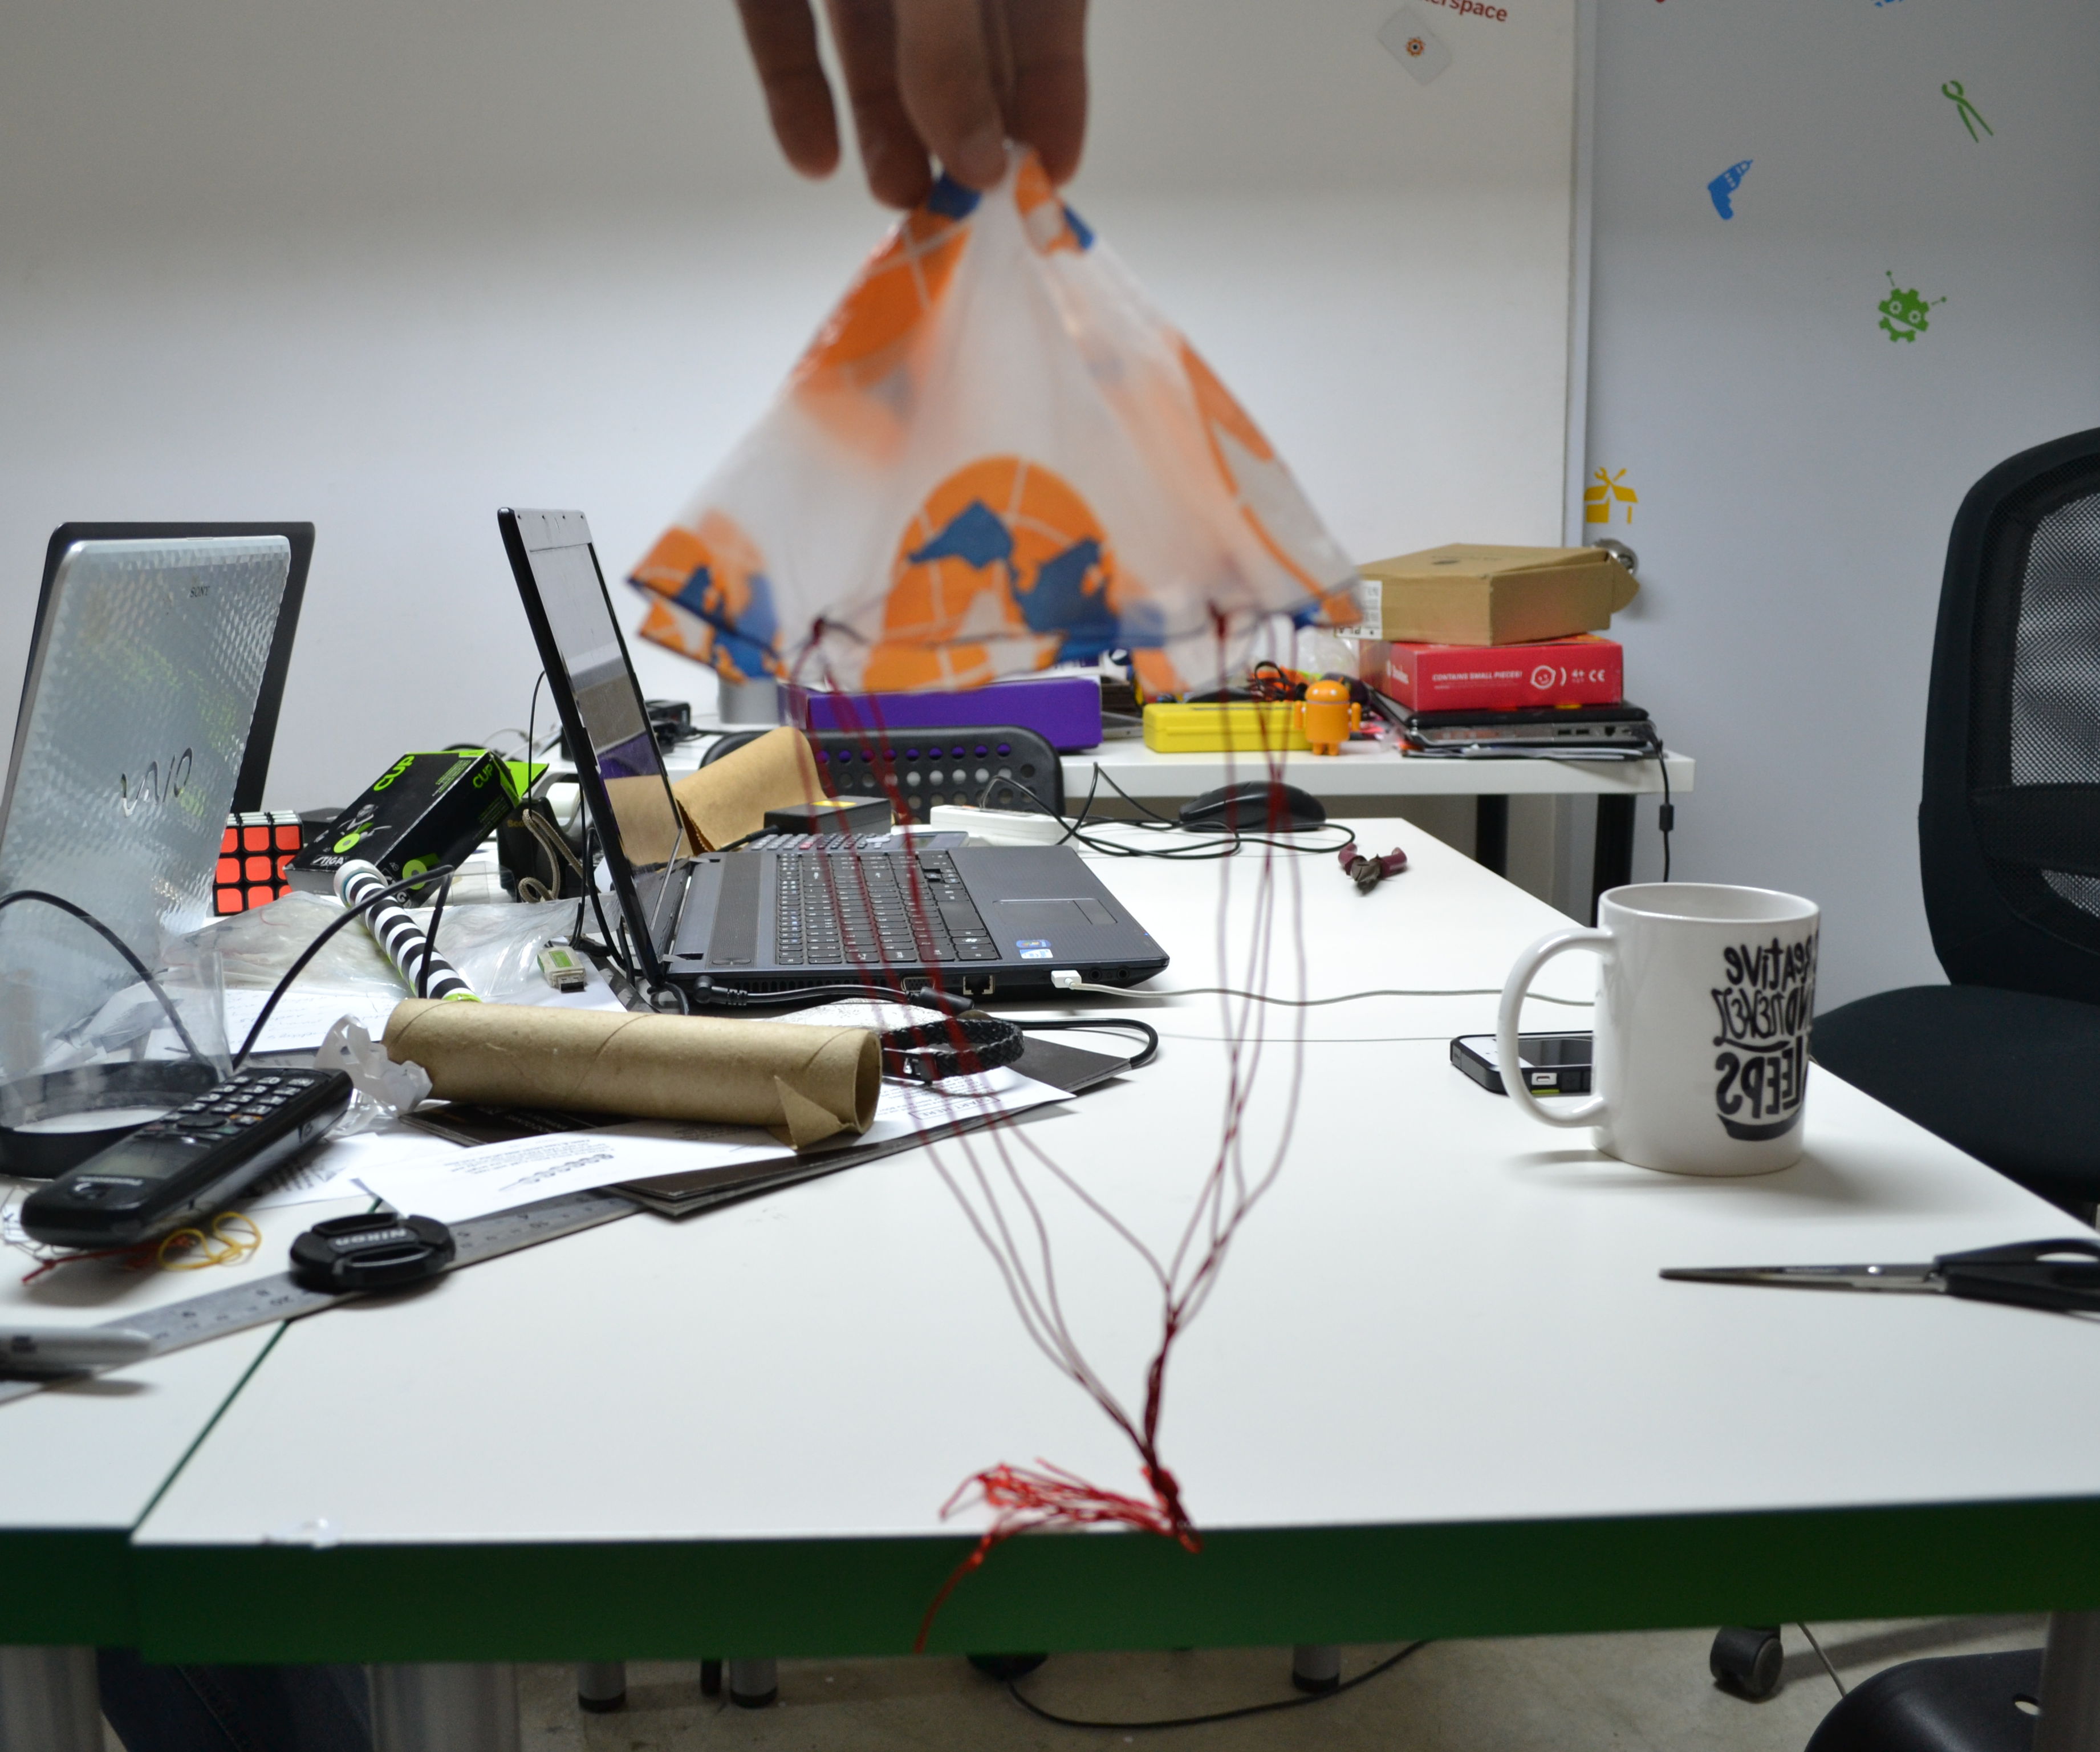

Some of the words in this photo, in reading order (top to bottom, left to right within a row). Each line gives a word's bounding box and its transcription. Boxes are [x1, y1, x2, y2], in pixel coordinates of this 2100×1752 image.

[190, 586, 210, 598] SONY
[1432, 673, 1468, 682] CONTAINS
[120, 747, 193, 818] VAIO
[373, 756, 415, 791] CUP
[473, 764, 493, 788] CUP
